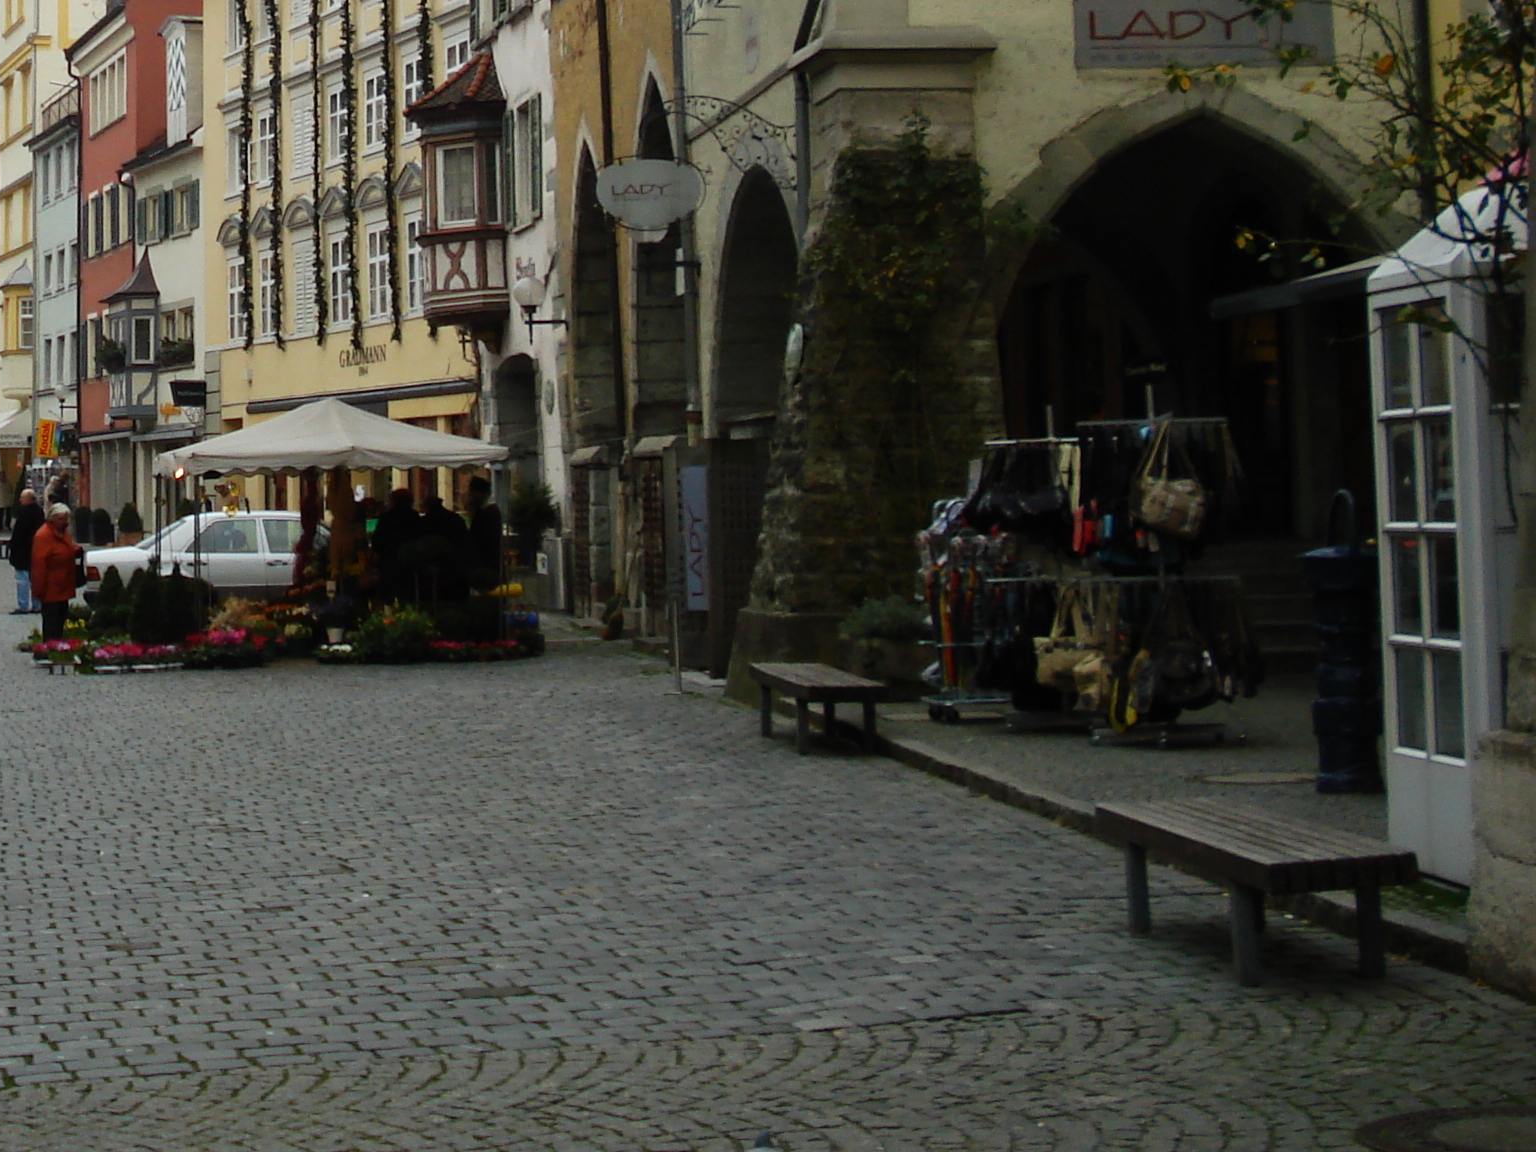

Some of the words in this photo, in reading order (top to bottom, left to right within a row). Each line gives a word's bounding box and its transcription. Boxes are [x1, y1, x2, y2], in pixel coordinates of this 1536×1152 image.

[1089, 9, 1260, 40] LADY
[611, 183, 672, 196] LADY
[339, 344, 386, 368] GRADMANN
[38, 423, 50, 456] Kodak
[687, 504, 705, 597] LADY
